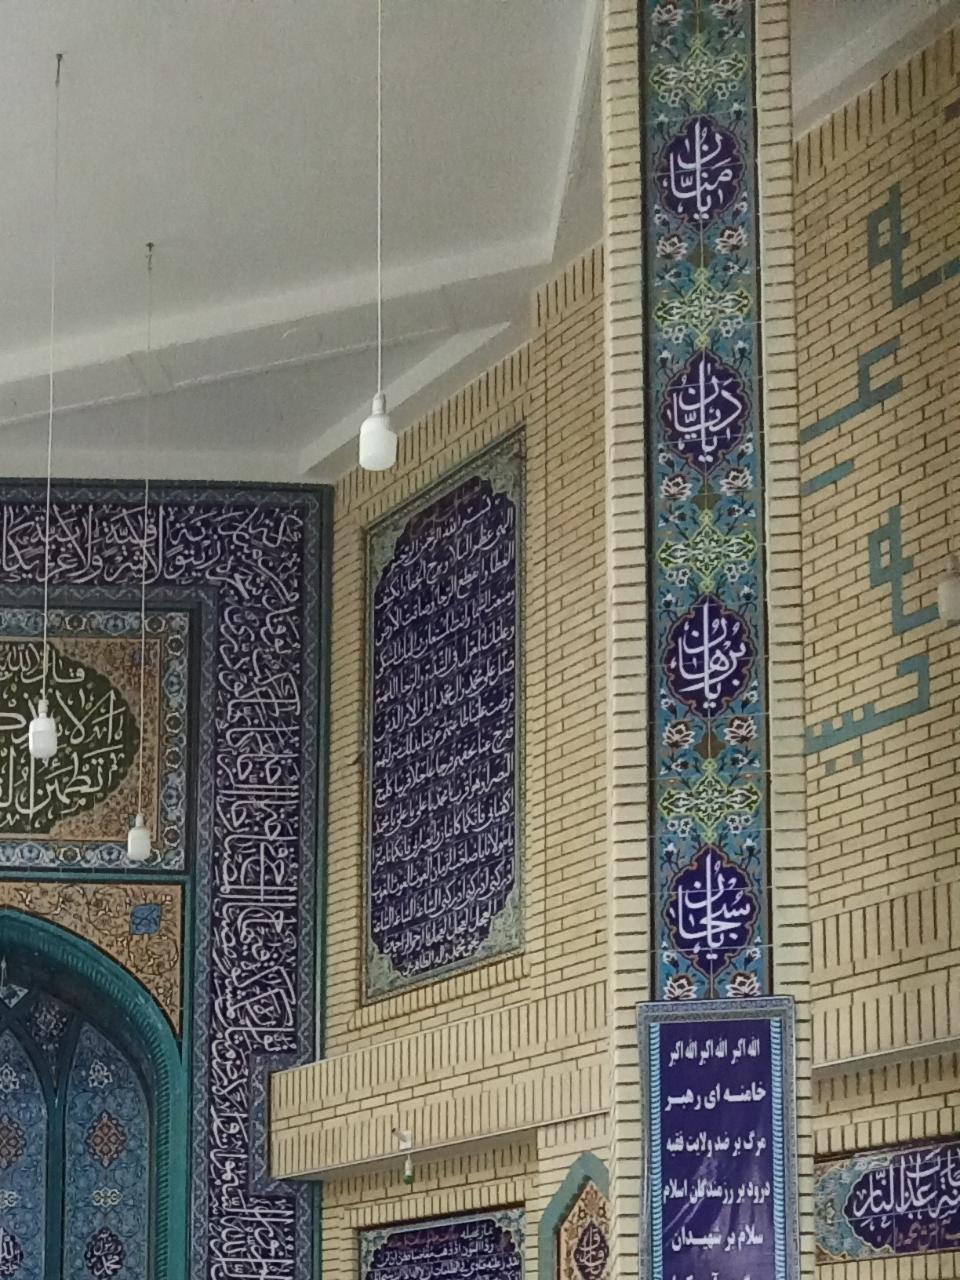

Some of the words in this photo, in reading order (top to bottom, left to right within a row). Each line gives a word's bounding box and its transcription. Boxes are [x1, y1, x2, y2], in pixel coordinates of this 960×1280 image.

[685, 1039, 697, 1059] الله
[715, 1037, 728, 1058] الله
[747, 1036, 760, 1057] الله
[664, 1088, 702, 1112] رهبر
[704, 1082, 720, 1110] ای
[666, 1130, 685, 1157] فقیه
[685, 1130, 712, 1158] ولایت
[714, 1131, 730, 1151] ضد
[732, 1136, 742, 1157] بر
[743, 1130, 767, 1157] مرگ
[663, 1178, 688, 1204] اسلام
[689, 1178, 734, 1205] رزمندگان
[736, 1183, 745, 1204] بر
[746, 1181, 771, 1204] درود
[671, 1224, 722, 1252] شهیدان
[724, 1231, 736, 1252] بر
[737, 1224, 764, 1251] سلام
